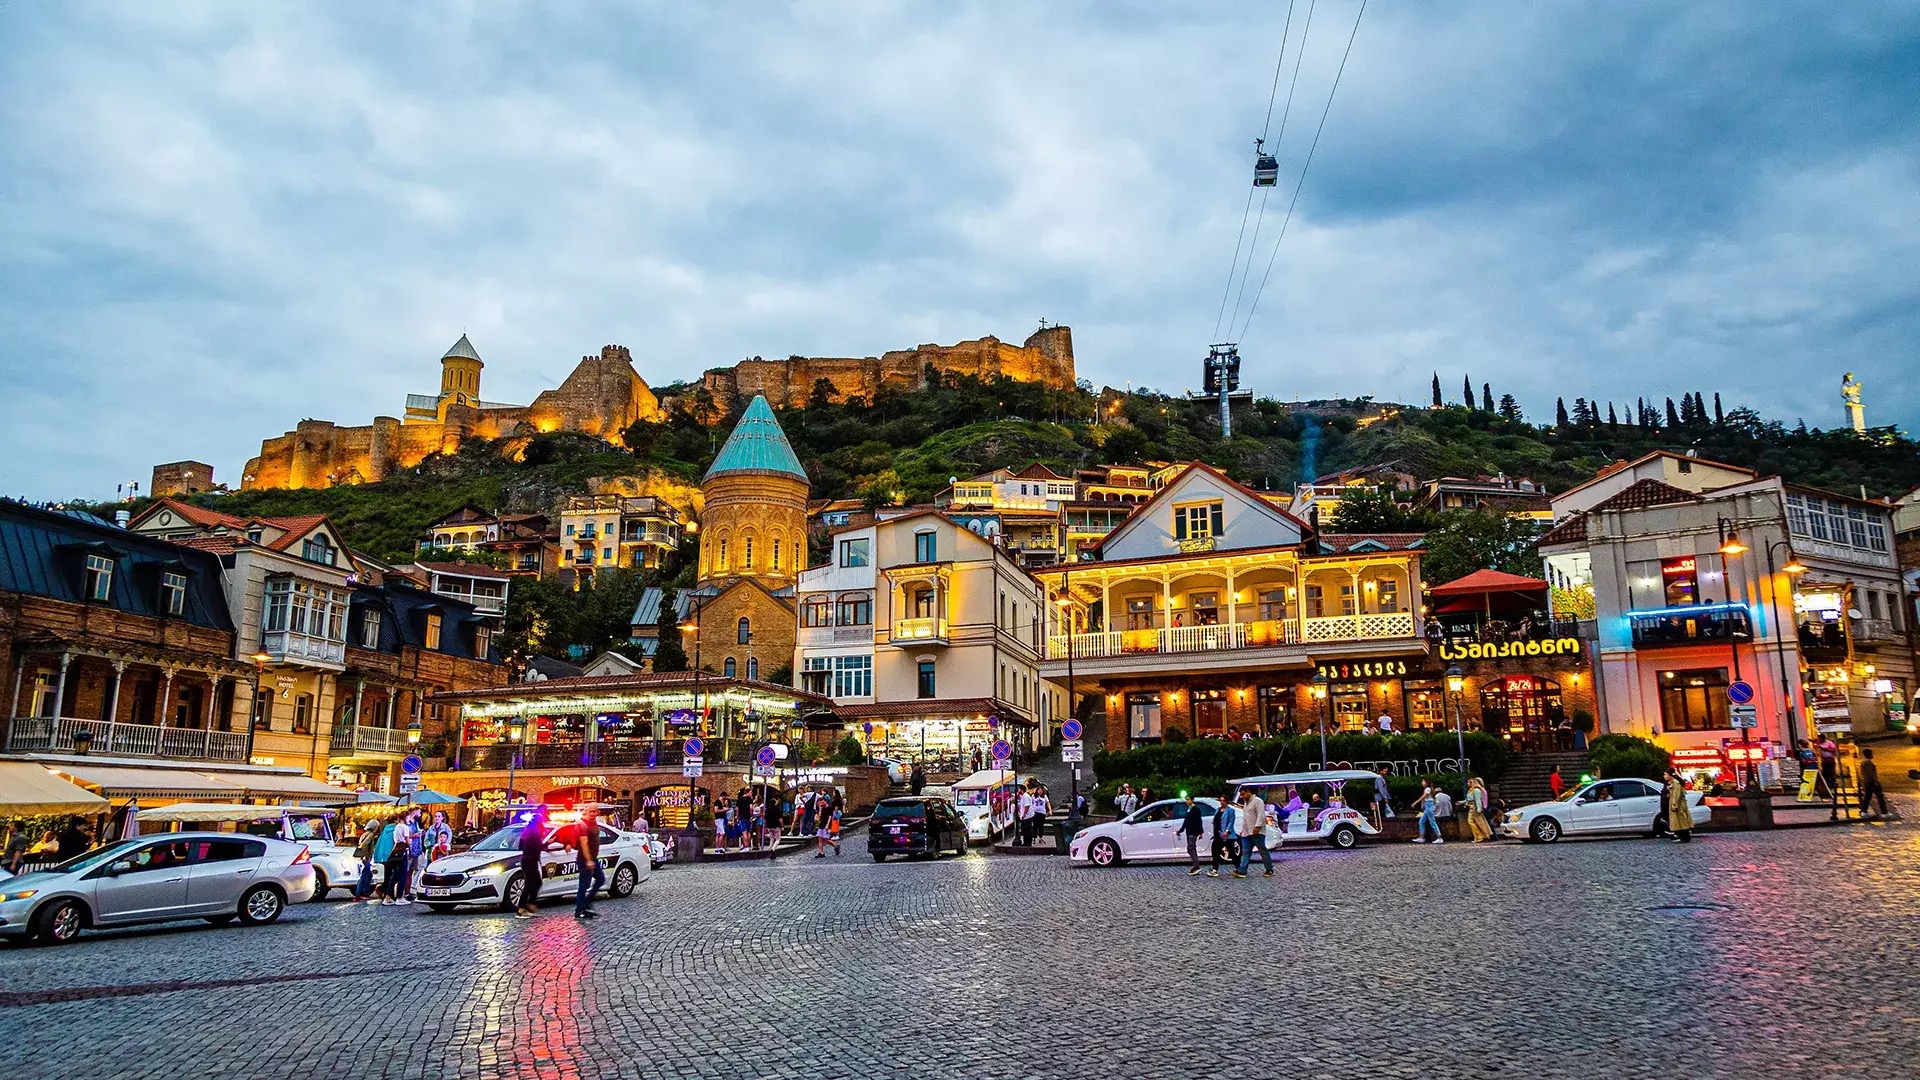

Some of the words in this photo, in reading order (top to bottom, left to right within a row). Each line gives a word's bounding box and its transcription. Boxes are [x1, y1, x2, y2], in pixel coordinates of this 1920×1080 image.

[1439, 638, 1580, 660] სამიკიტნო
[1319, 661, 1407, 679] მაჭახელა
[1506, 680, 1532, 691] 24/24
[282, 689, 289, 699] 6
[551, 776, 580, 787] WINE
[583, 775, 609, 787] BAR
[655, 789, 692, 798] CHATEA
[642, 795, 706, 807] MUKHRANI
[1328, 812, 1341, 821] CITY
[1343, 811, 1359, 819] TOUR
[561, 857, 609, 875] პოია
[473, 877, 491, 886] 7127
